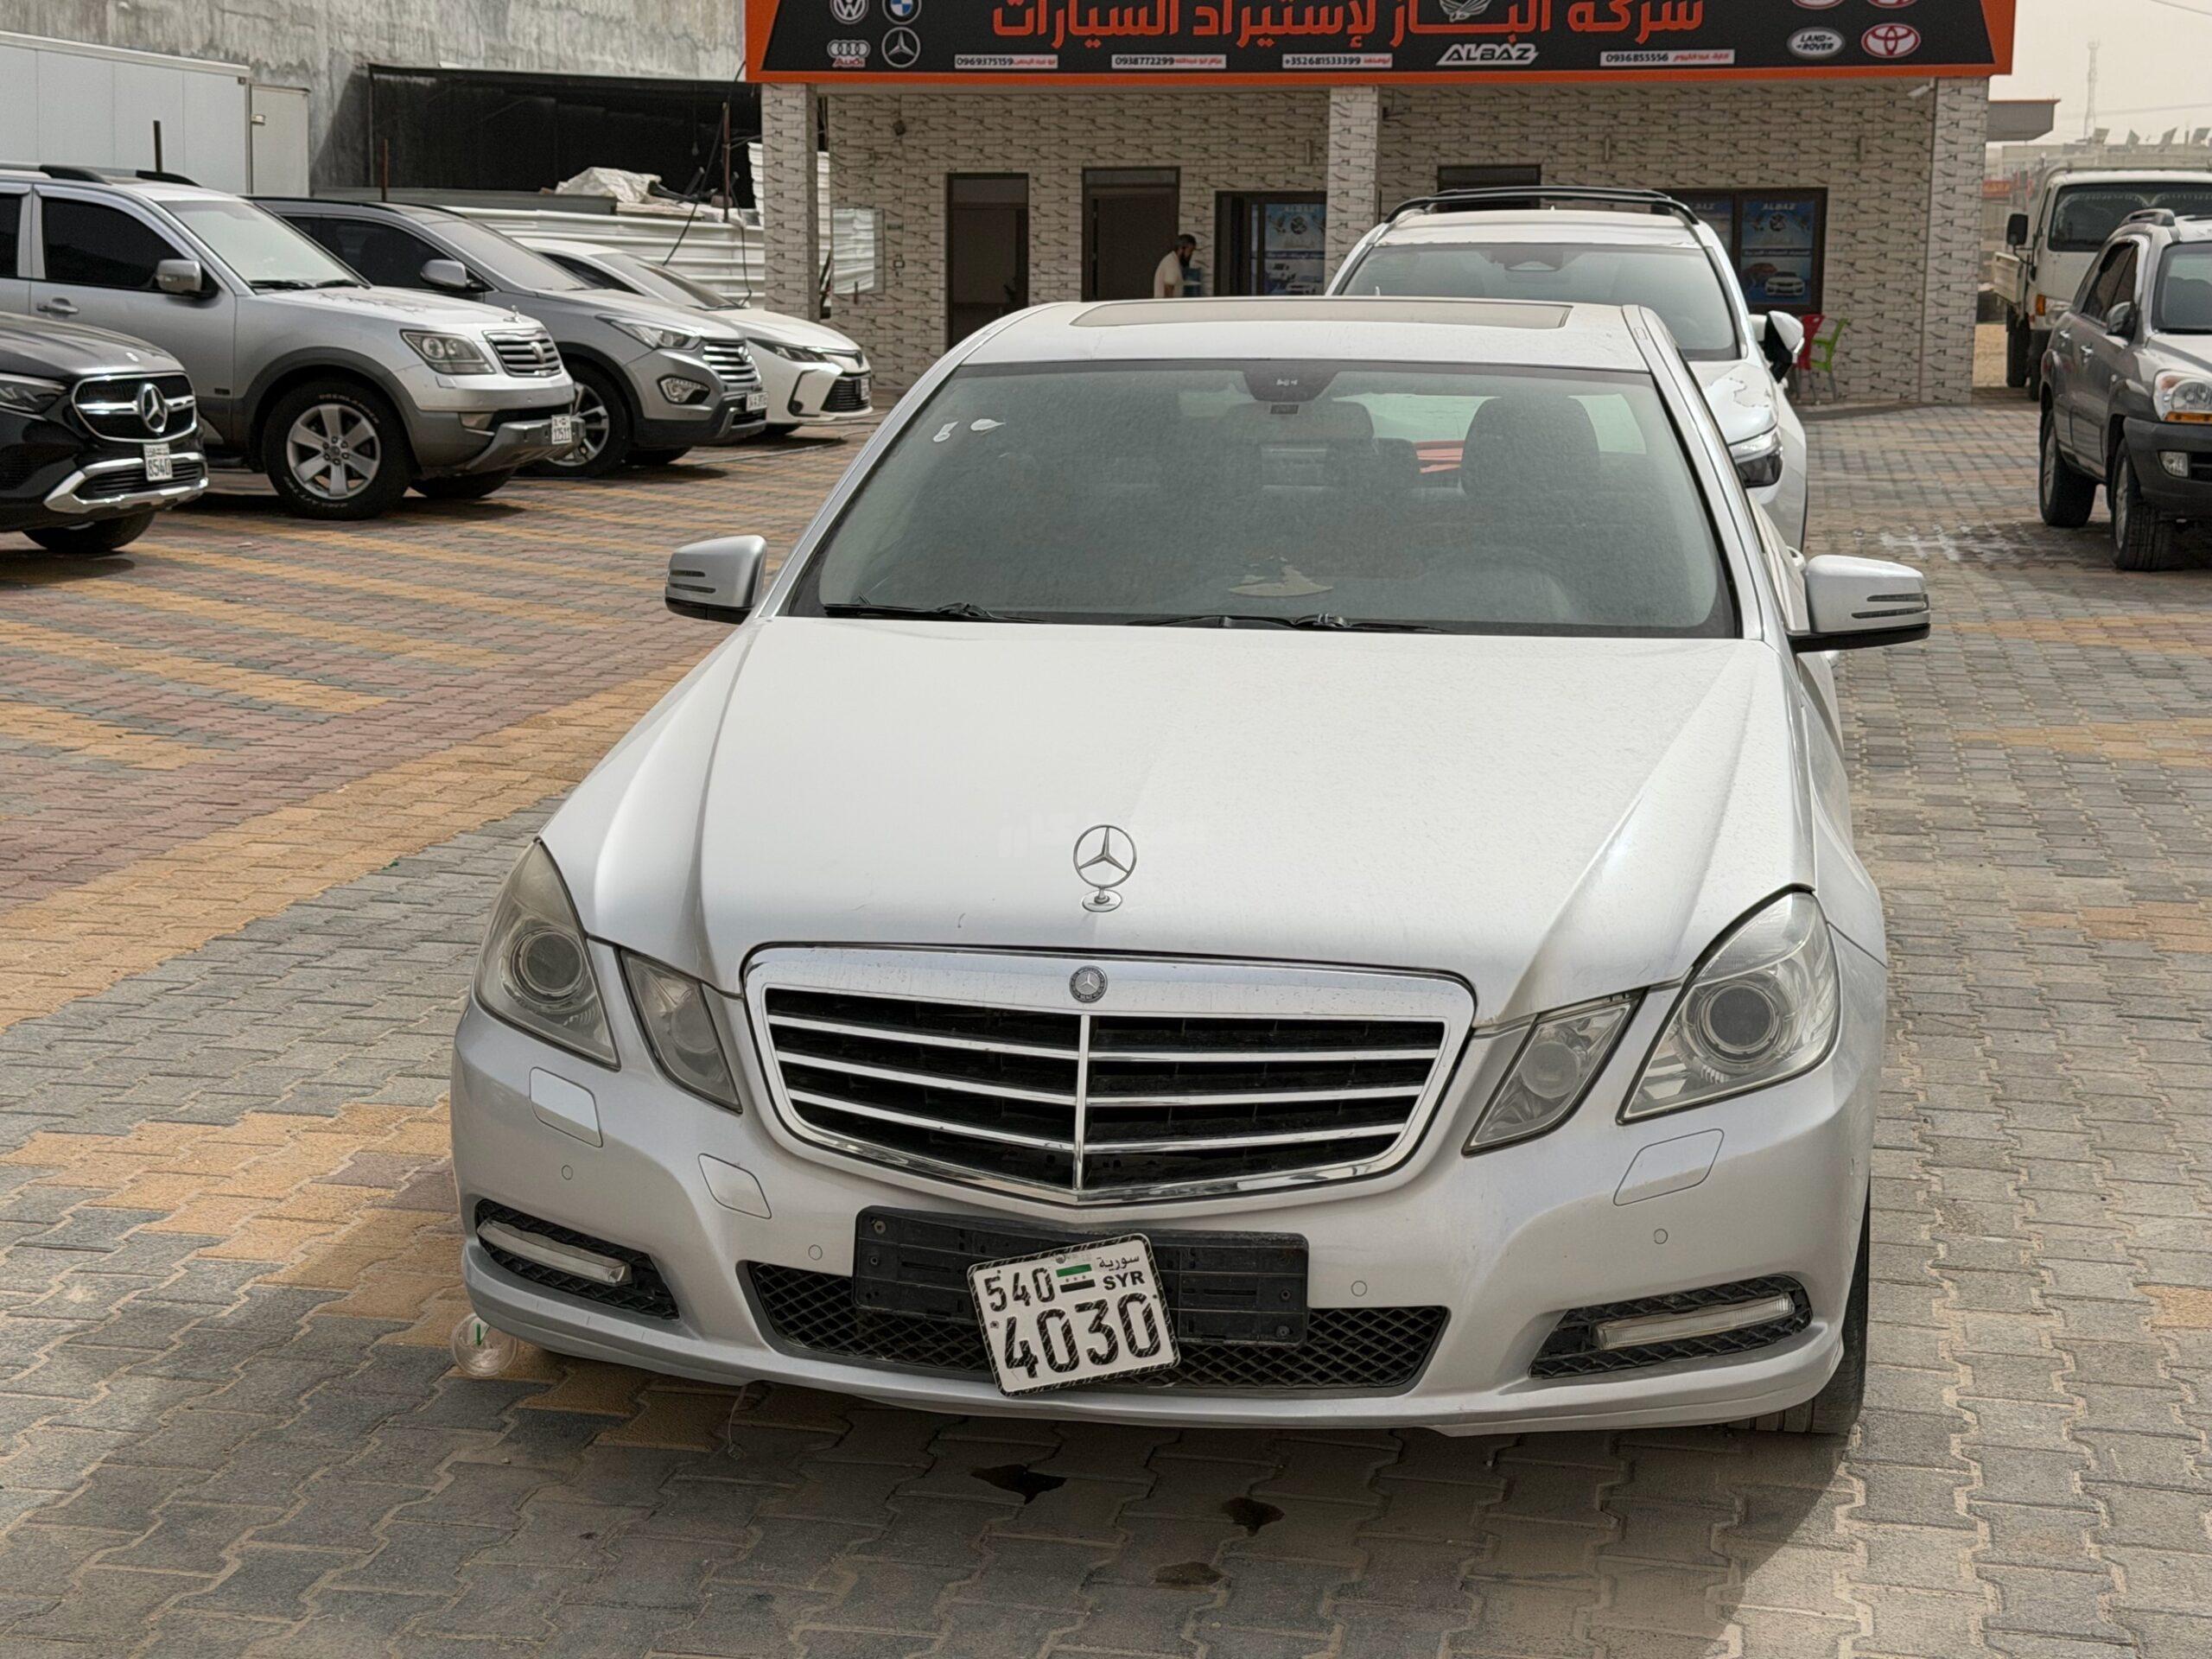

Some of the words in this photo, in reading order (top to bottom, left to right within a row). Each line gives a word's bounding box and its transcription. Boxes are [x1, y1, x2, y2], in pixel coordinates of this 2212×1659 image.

[993, 0, 1179, 48] السيارات
[1441, 46, 1535, 62] ALBAZ
[1097, 1254, 1141, 1271] سورية
[984, 1267, 1056, 1312] 540
[1102, 1269, 1146, 1291] SYR
[1004, 1292, 1161, 1379] 4030
